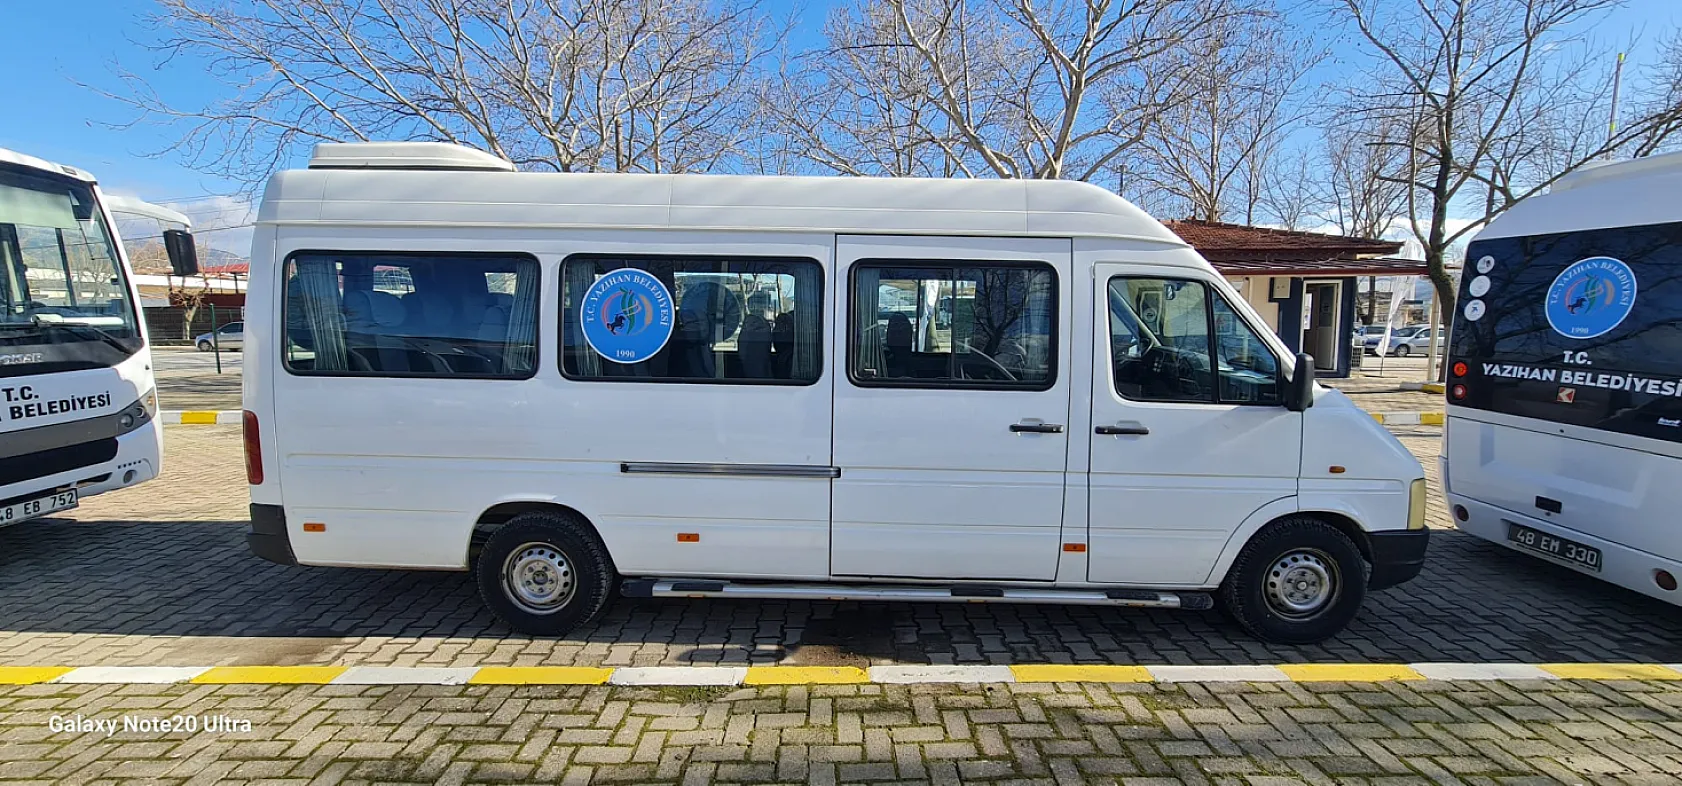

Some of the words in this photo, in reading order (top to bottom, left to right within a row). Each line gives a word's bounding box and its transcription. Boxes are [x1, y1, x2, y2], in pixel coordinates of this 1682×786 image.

[590, 274, 631, 302] YAZIHAN
[633, 274, 670, 327] BELEDİYESİ
[616, 350, 636, 358] 1990
[1563, 350, 1592, 365] T.C.
[1482, 363, 1556, 382] YAZIHAN
[1560, 370, 1682, 397] BELEDİYESİ
[2, 386, 39, 401] T.C.
[9, 391, 111, 420] BELEDİYESİ
[24, 501, 40, 515] EB
[50, 492, 75, 508] 752
[1516, 529, 1535, 545] 48
[1540, 538, 1560, 553] EM
[1566, 544, 1597, 565] 330
